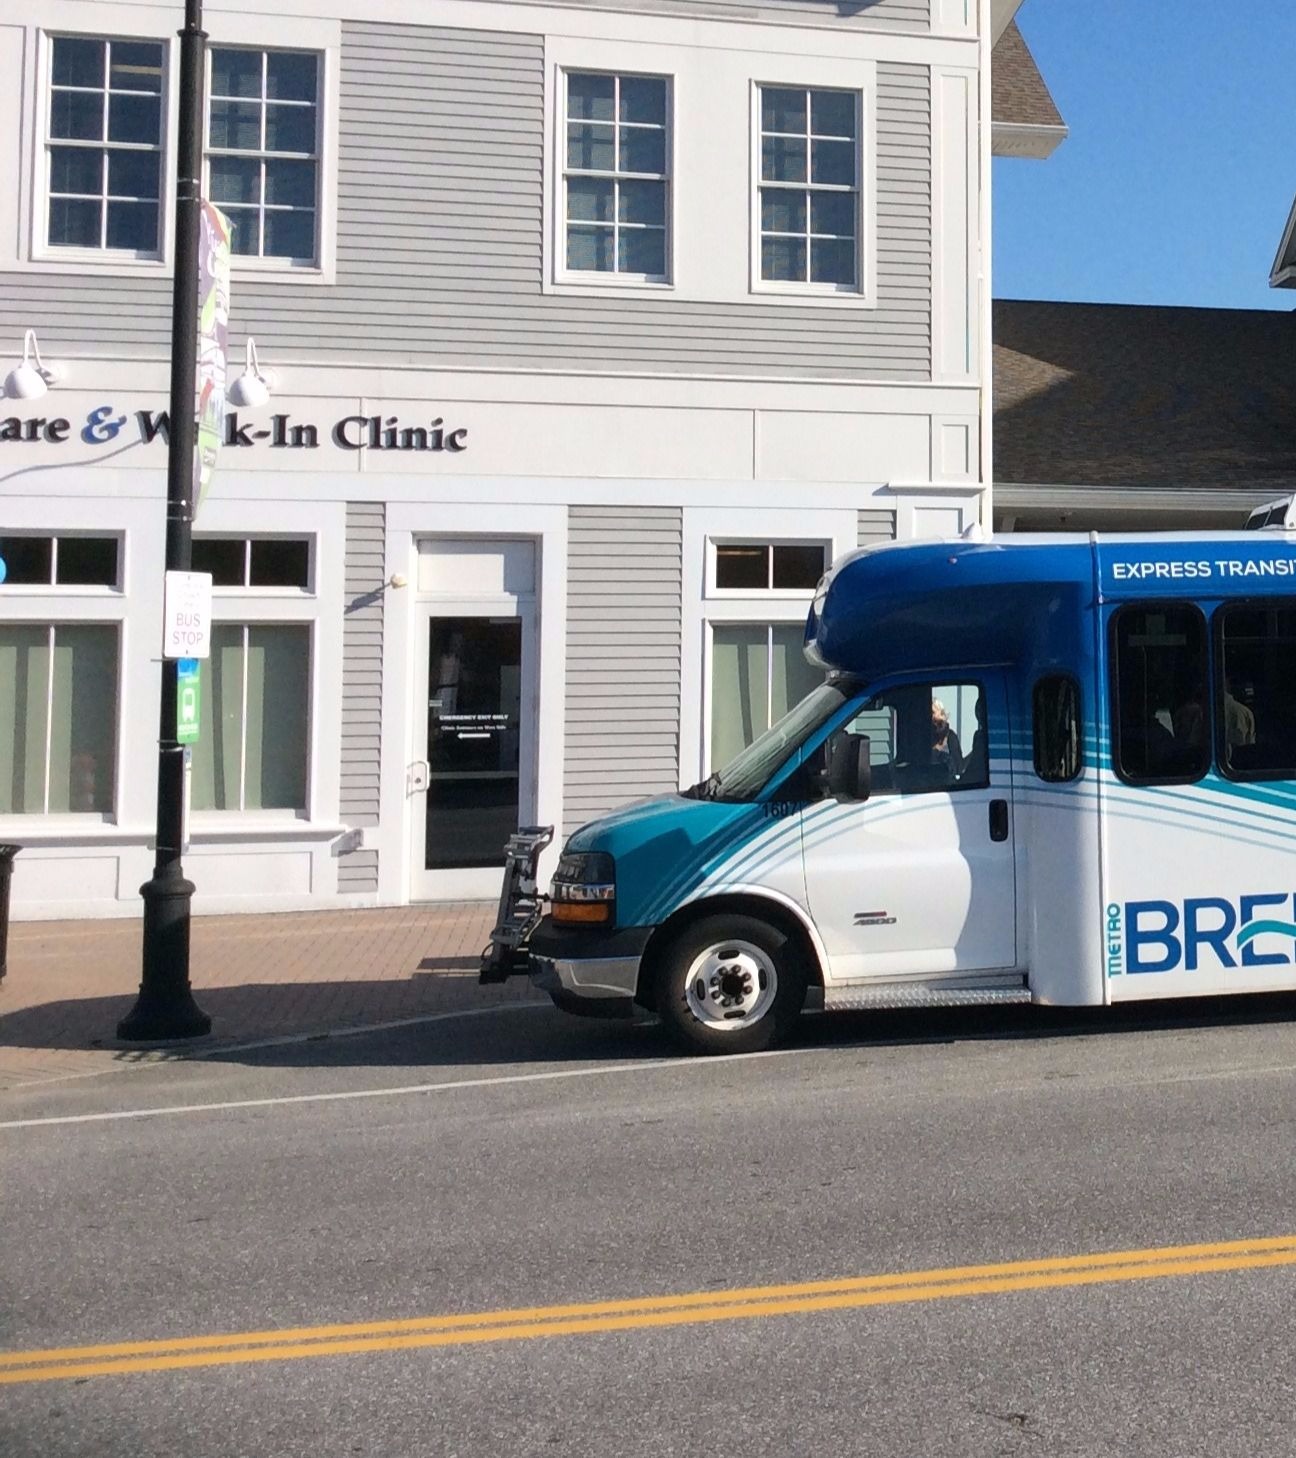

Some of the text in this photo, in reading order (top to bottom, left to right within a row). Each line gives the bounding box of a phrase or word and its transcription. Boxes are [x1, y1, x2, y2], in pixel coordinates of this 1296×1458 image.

[80, 405, 127, 445] &
[134, 410, 319, 449] Wk-In
[331, 415, 468, 453] Clinic
[1112, 561, 1212, 579] EXPRESS
[176, 612, 201, 627] BUS
[172, 630, 204, 646] STOP
[1107, 902, 1122, 979] METRO
